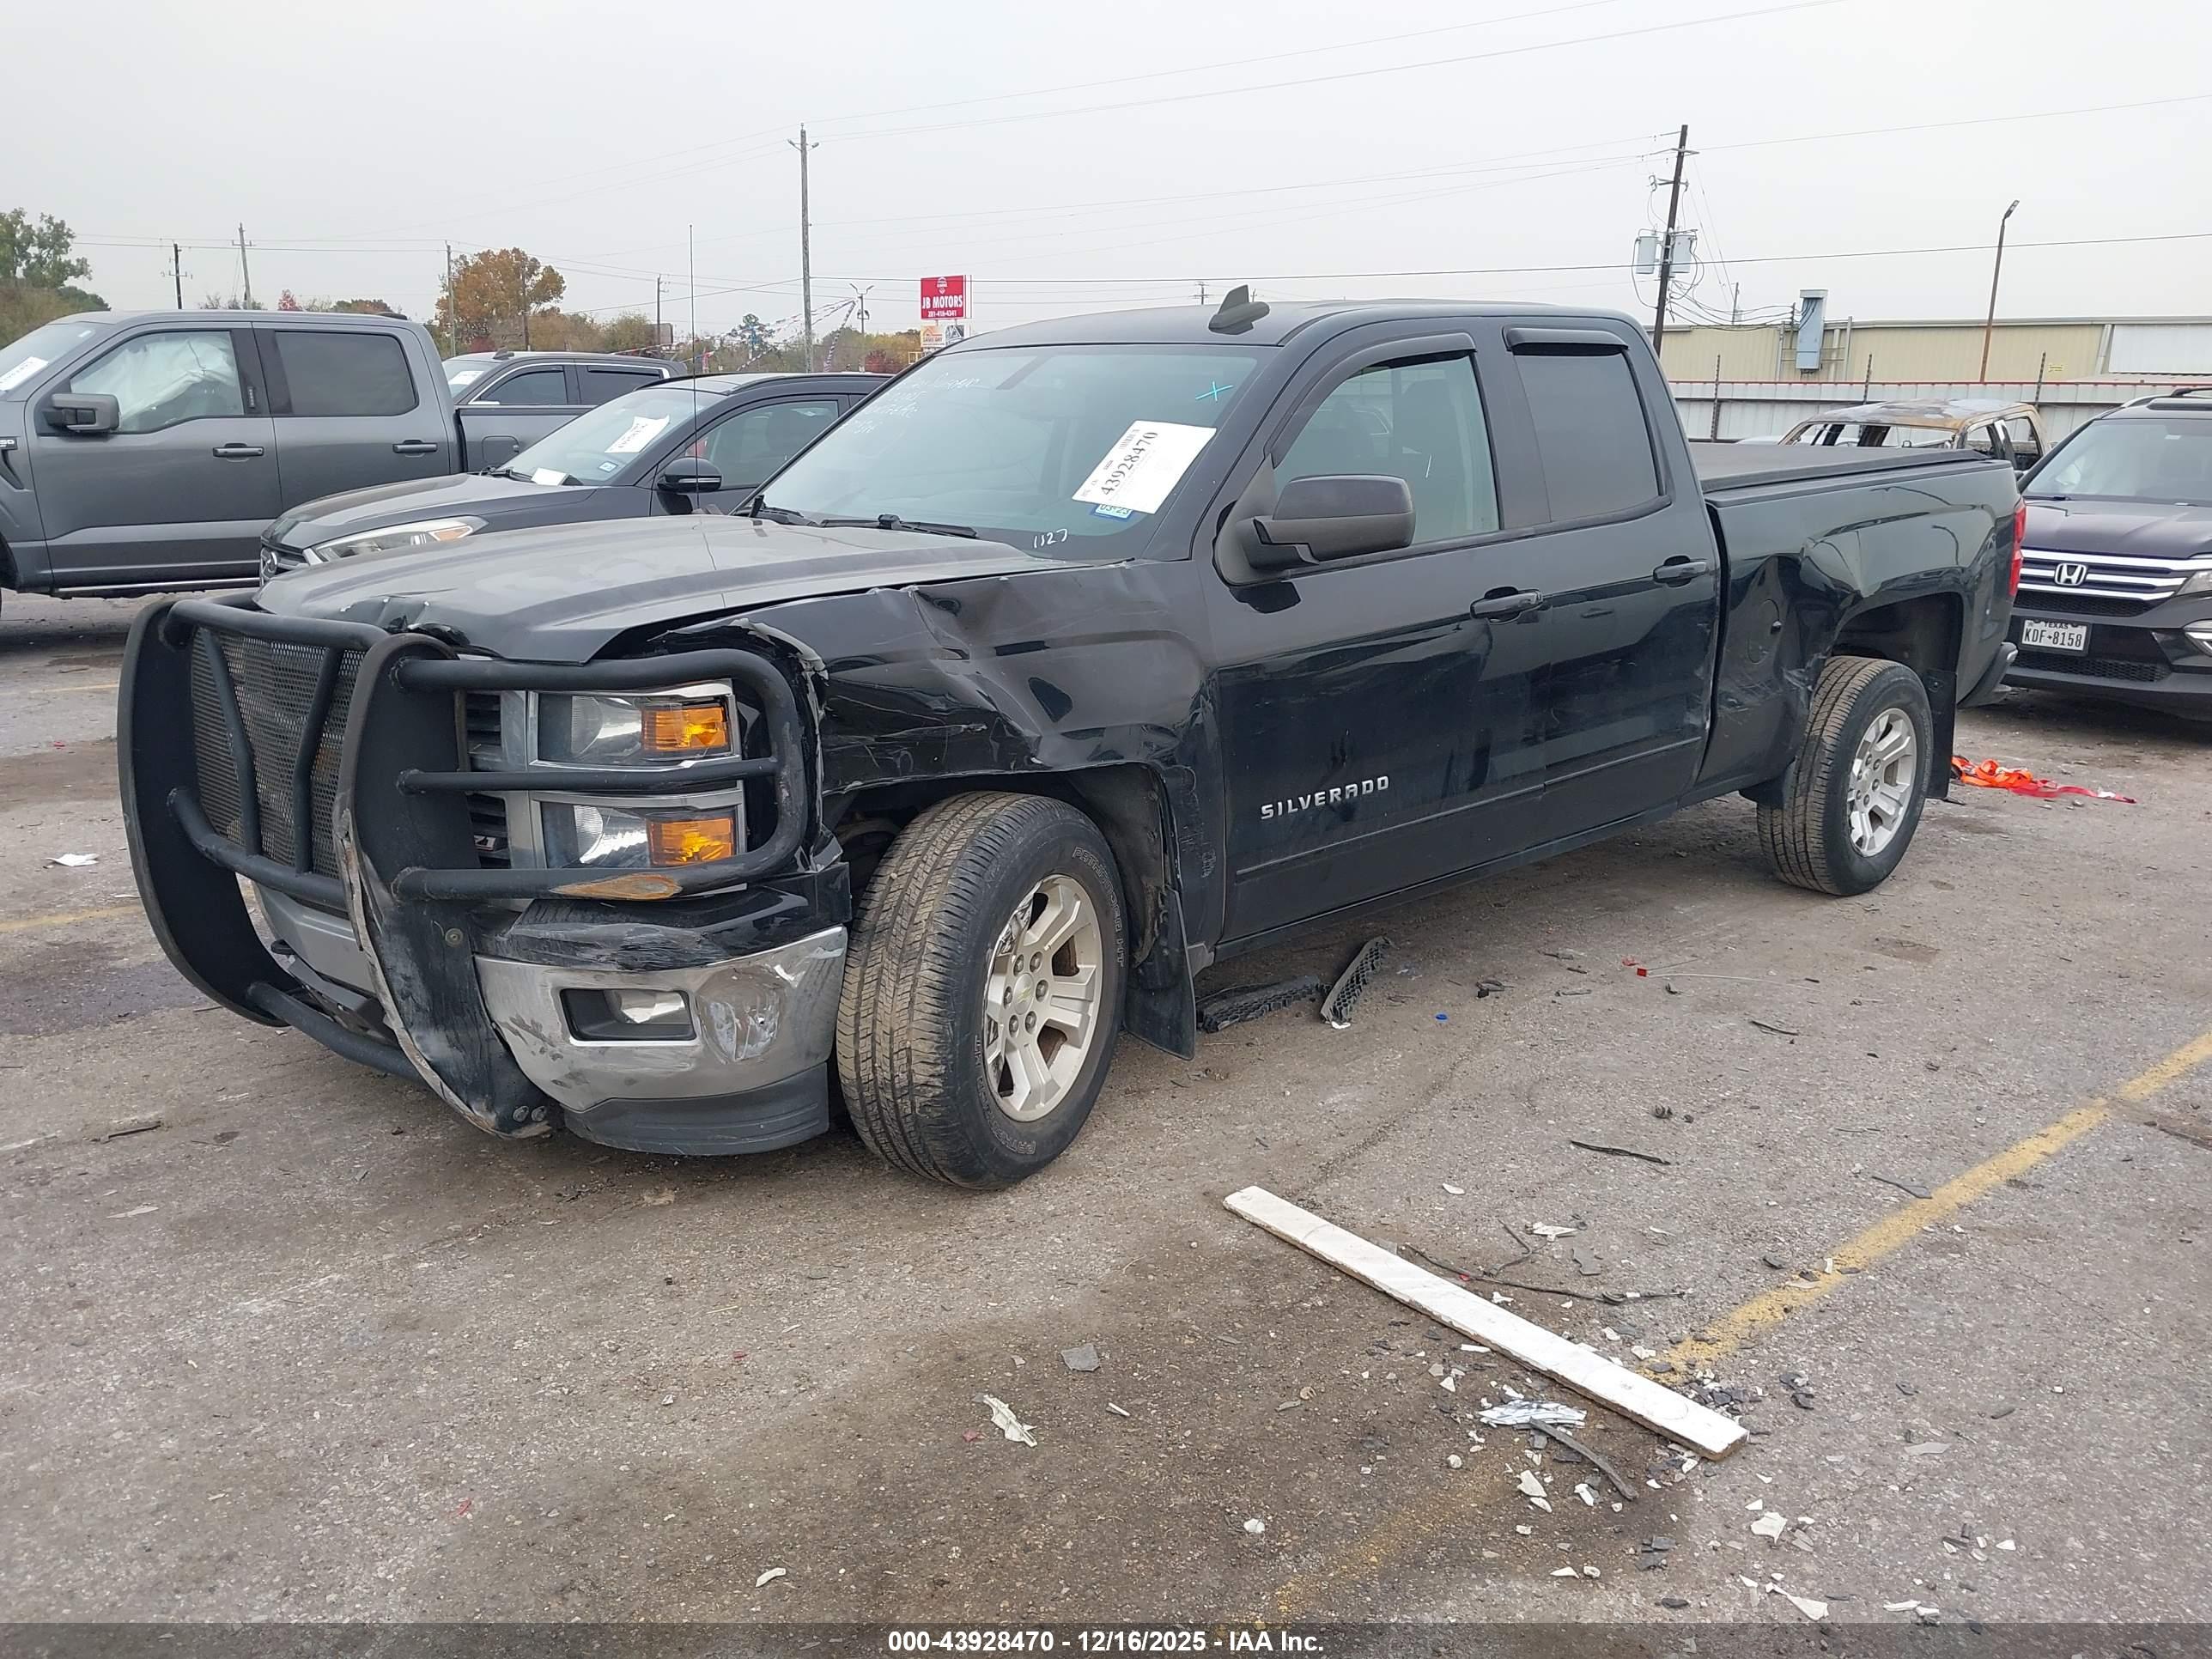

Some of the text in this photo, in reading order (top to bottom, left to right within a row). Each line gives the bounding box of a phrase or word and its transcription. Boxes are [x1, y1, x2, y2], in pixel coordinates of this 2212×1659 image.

[922, 295, 963, 309] JB MOTORS
[1101, 432, 1158, 495] 43928470
[1260, 775, 1390, 820] SILVERADO
